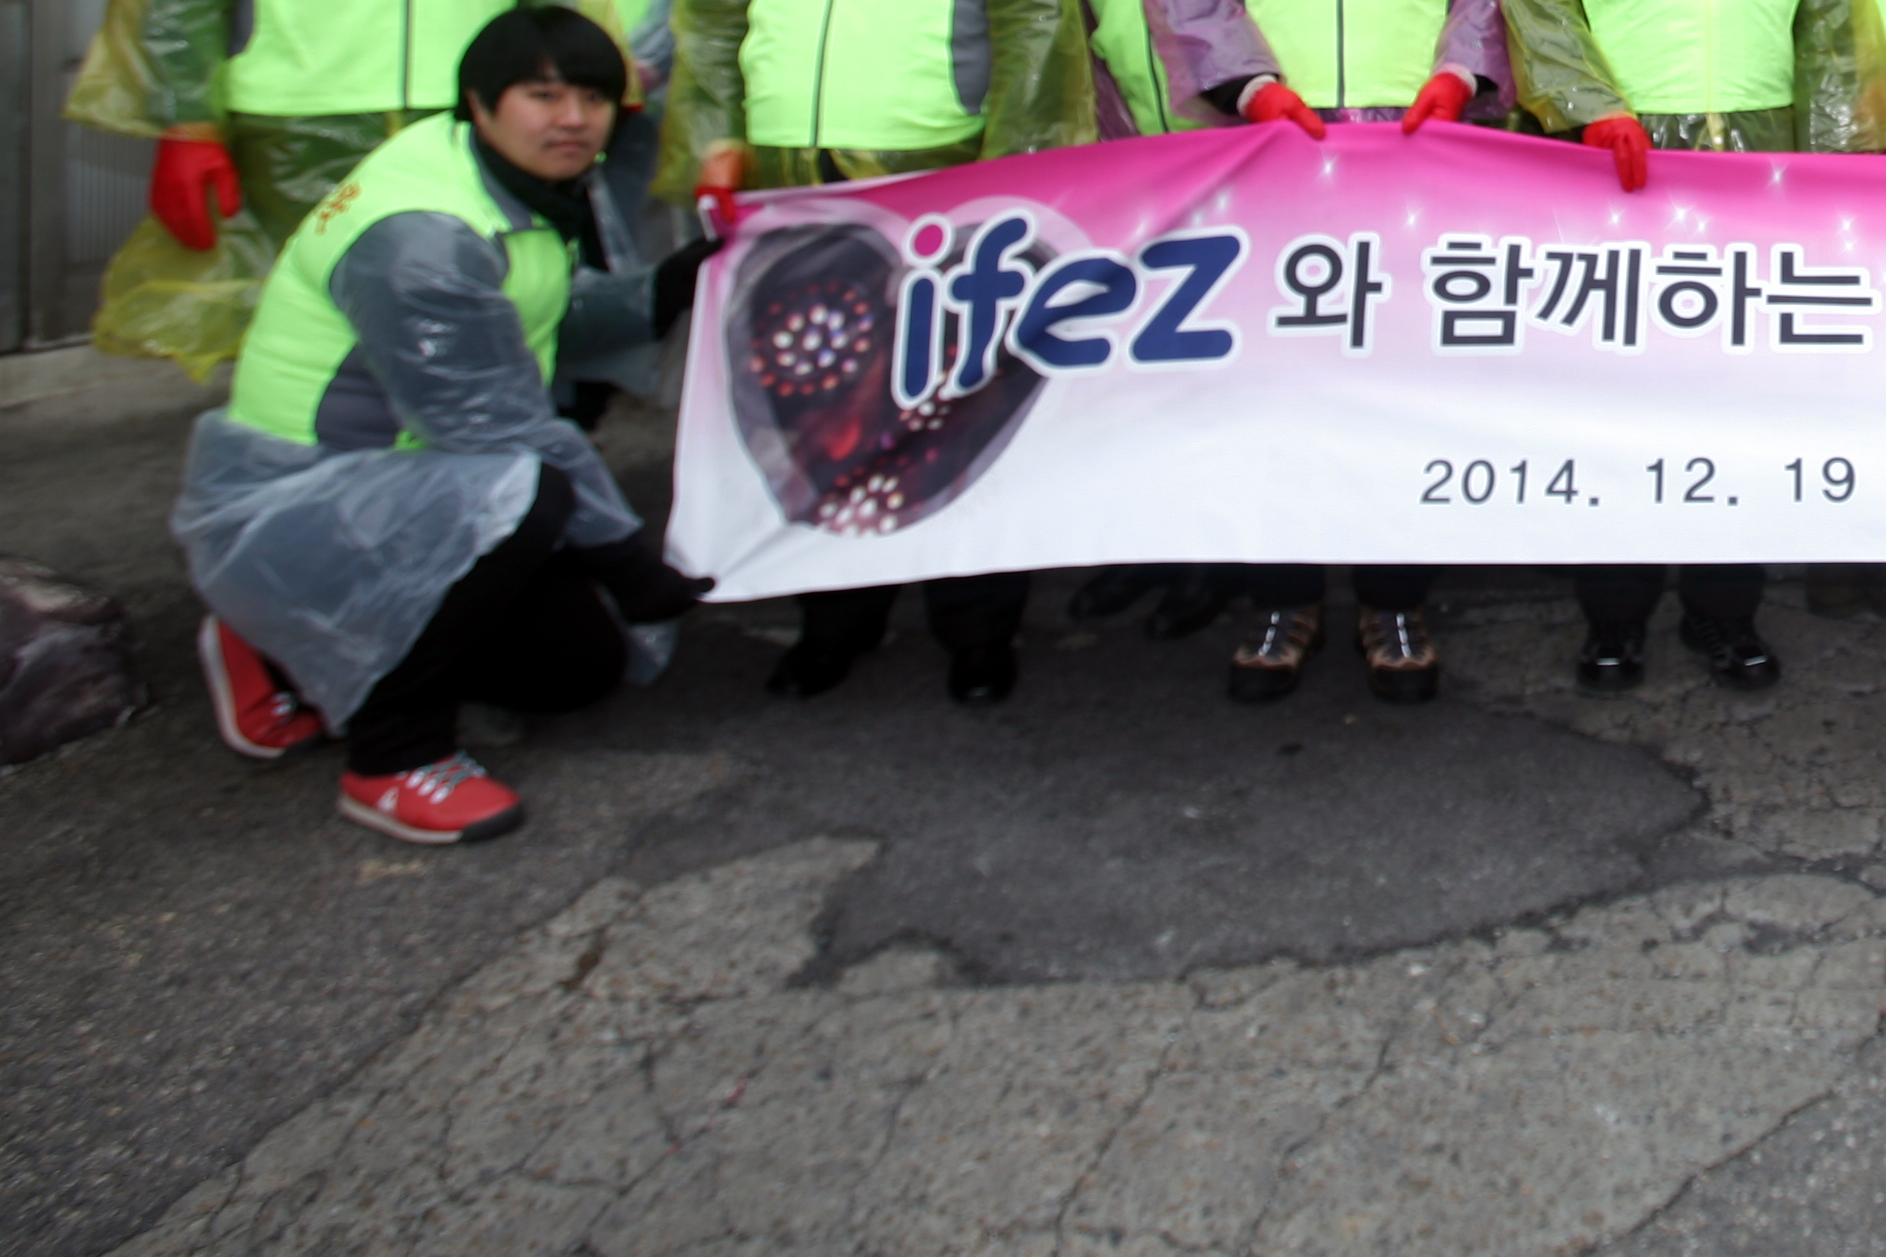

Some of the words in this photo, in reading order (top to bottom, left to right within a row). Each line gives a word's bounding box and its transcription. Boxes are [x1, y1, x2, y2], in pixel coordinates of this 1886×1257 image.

[902, 215, 1242, 399] ifez
[1275, 241, 1383, 349] 와
[1429, 241, 1873, 348] 함께하는
[1418, 458, 1600, 507] 2014.
[1645, 456, 1740, 507] 12.
[1784, 456, 1857, 503] 19
